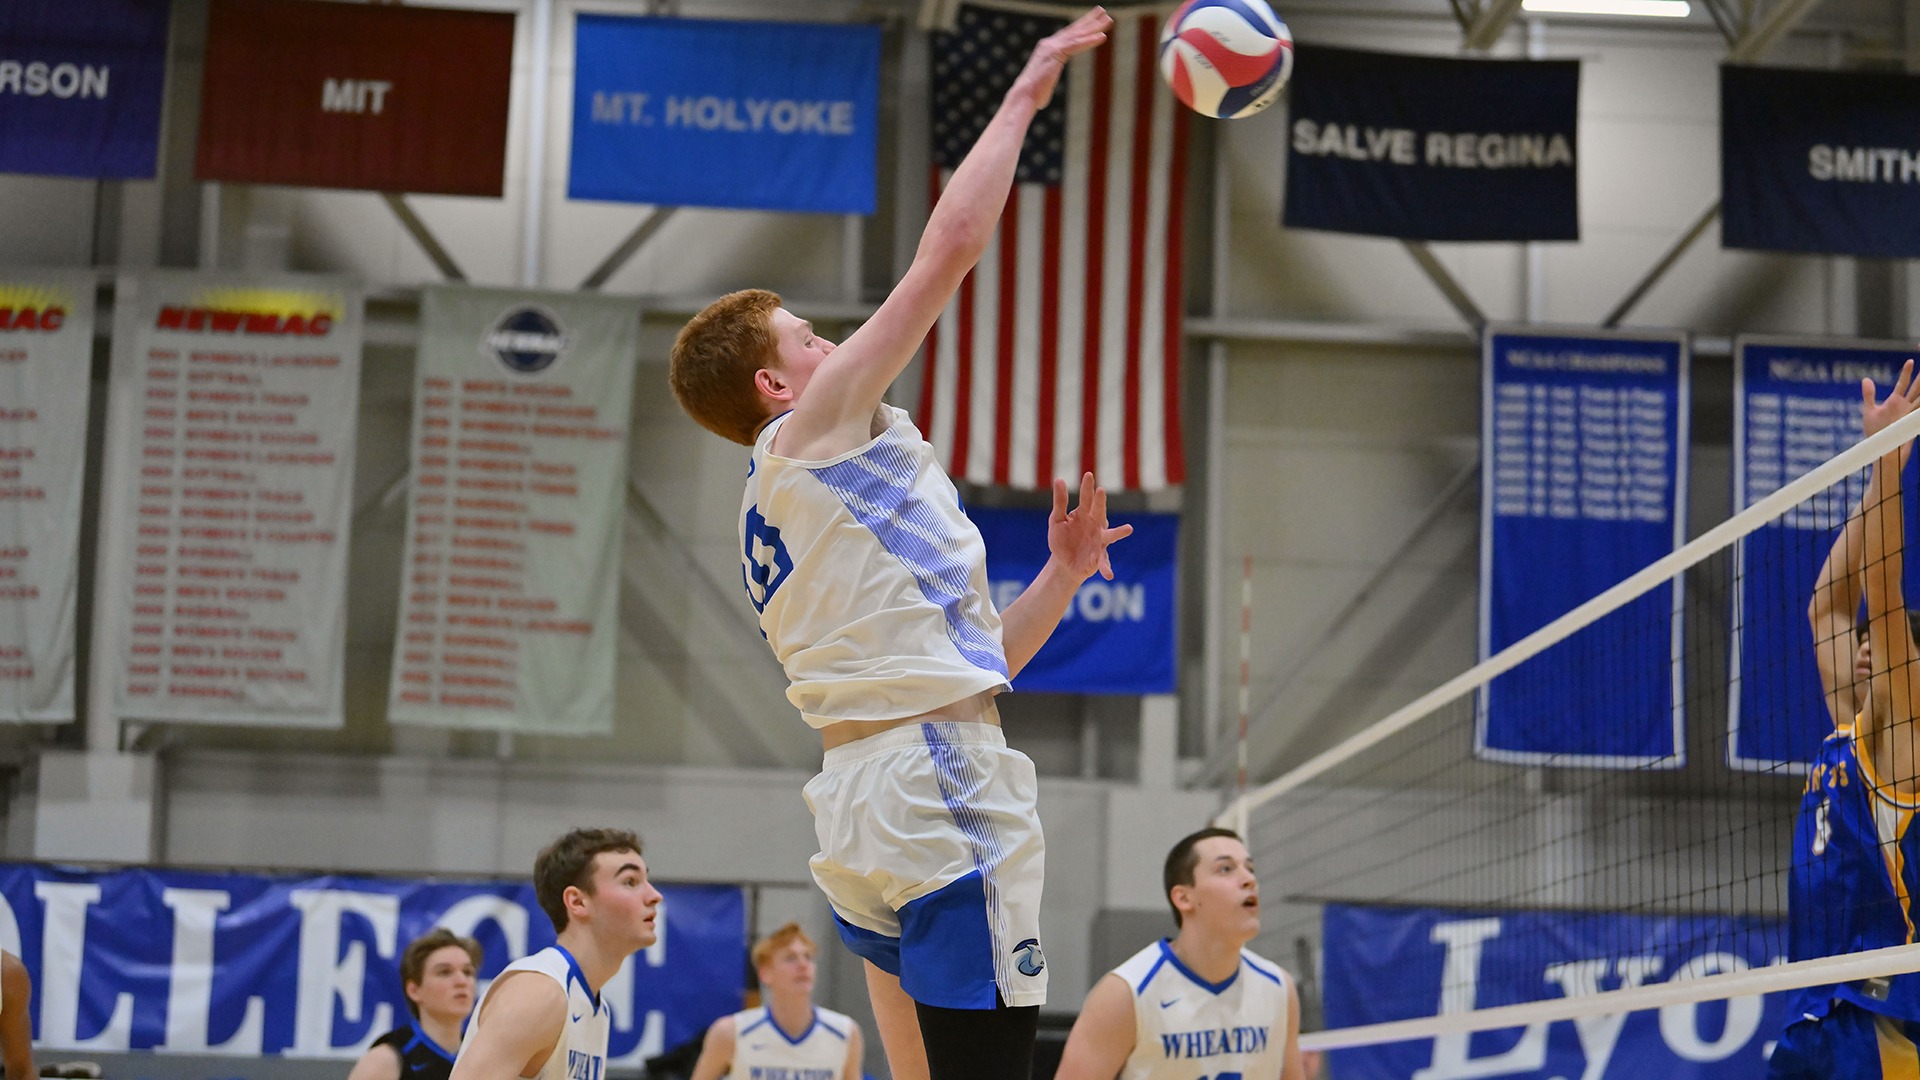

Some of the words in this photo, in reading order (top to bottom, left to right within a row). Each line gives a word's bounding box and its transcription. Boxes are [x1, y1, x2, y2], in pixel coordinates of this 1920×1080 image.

[0, 60, 109, 99] RSON
[322, 79, 391, 115] MIT
[592, 92, 654, 127] MT.
[665, 96, 854, 135] HOLYOKE
[1293, 119, 1416, 164] SALVE
[1425, 132, 1572, 168] REGINA
[1808, 144, 1920, 184] SMITH
[157, 306, 333, 336] NEWMAC
[1411, 917, 1787, 1080] Lyo
[1161, 1026, 1269, 1060] WHEATON
